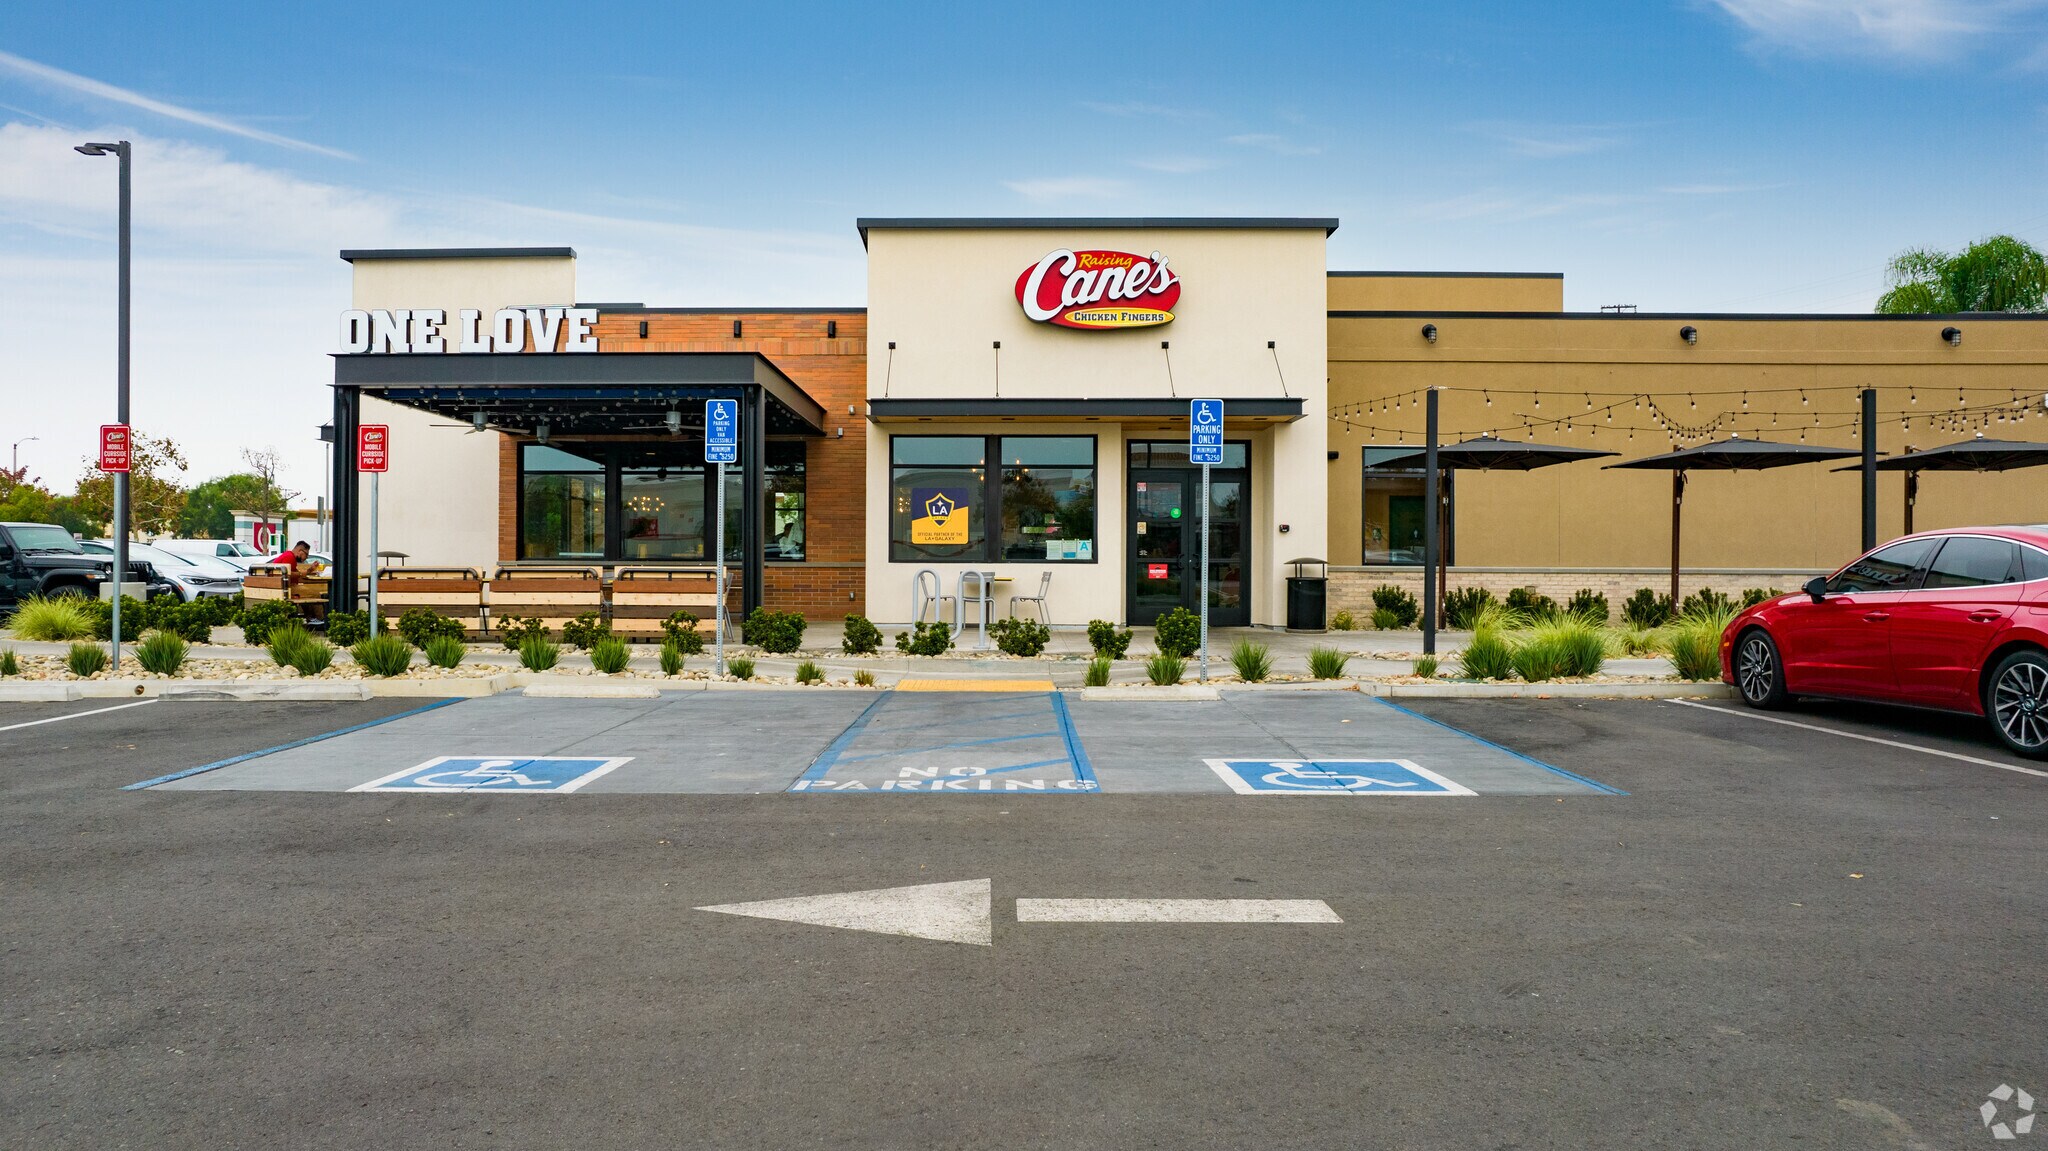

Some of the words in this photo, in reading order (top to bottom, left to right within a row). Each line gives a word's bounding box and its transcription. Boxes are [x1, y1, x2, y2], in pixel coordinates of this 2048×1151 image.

[1078, 254, 1132, 268] Raising
[1023, 248, 1180, 321] Cane's
[1074, 312, 1117, 321] CHICKEN
[1121, 312, 1164, 321] FINGERS
[340, 309, 447, 353] ONE
[459, 309, 599, 353] LOVE
[1193, 425, 1221, 434] PARKING
[1198, 435, 1216, 444] ONLY
[932, 506, 948, 515] LA
[1080, 542, 1088, 550] A
[898, 766, 986, 777] NO
[792, 779, 1098, 791] PARKING
